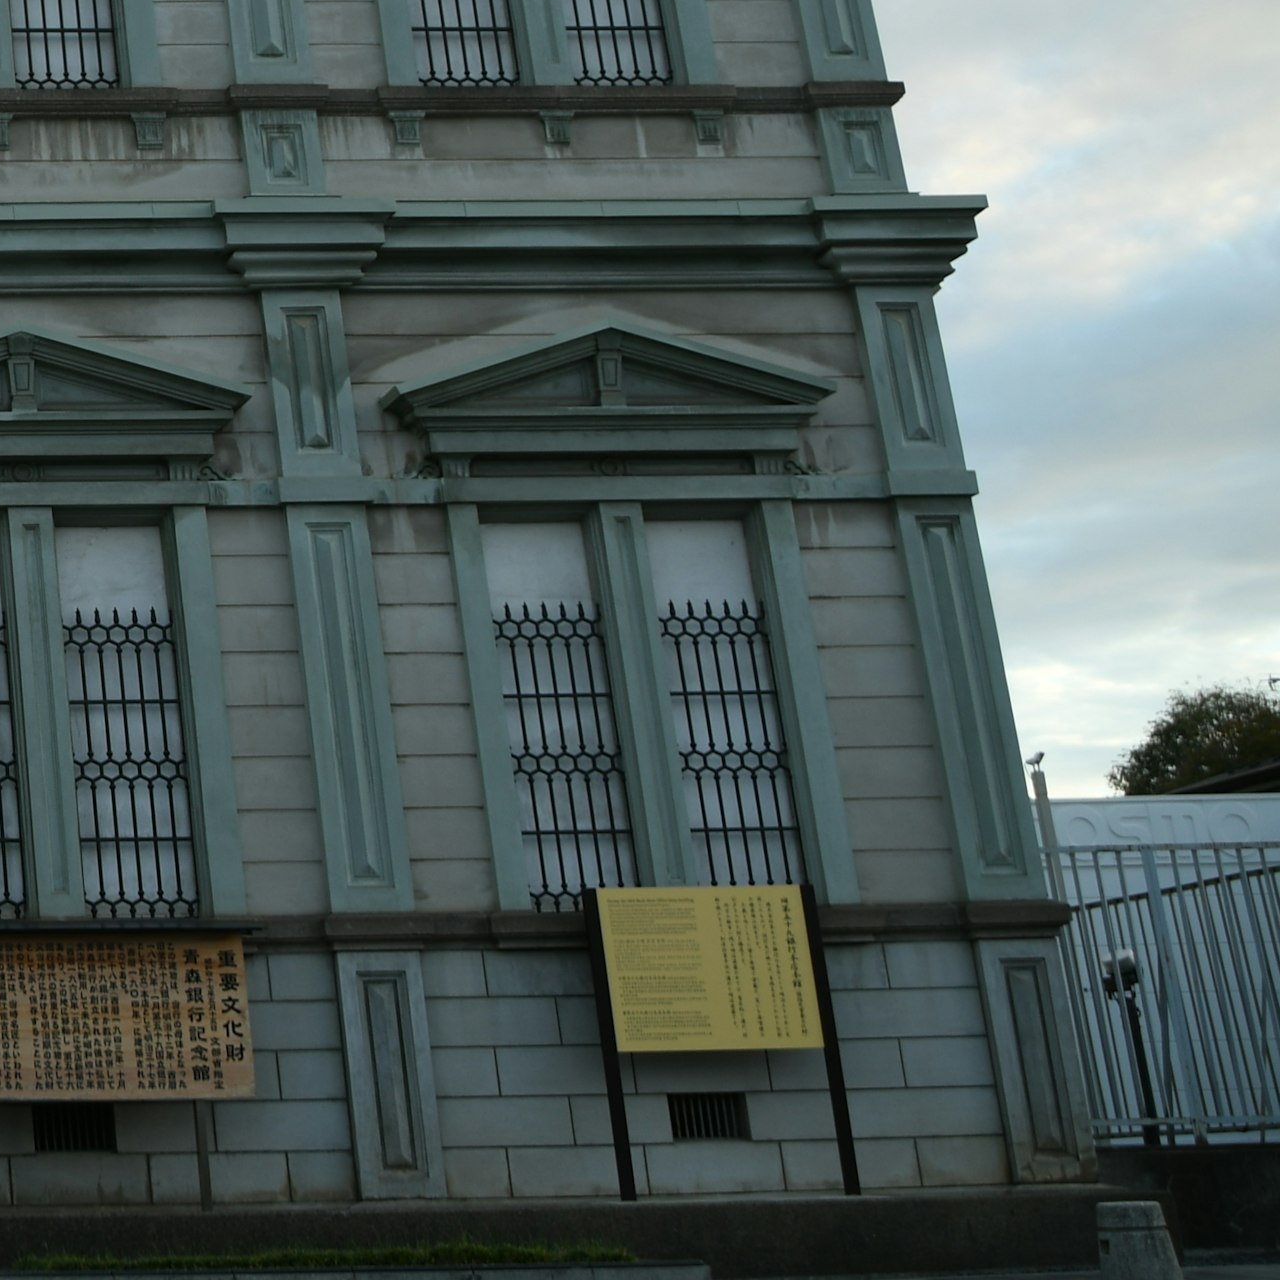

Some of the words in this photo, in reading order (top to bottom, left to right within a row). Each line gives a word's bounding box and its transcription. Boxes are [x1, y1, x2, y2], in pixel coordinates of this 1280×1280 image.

[183, 948, 210, 1081] 青森銀行記念館
[217, 949, 246, 1062] 重要文化財
